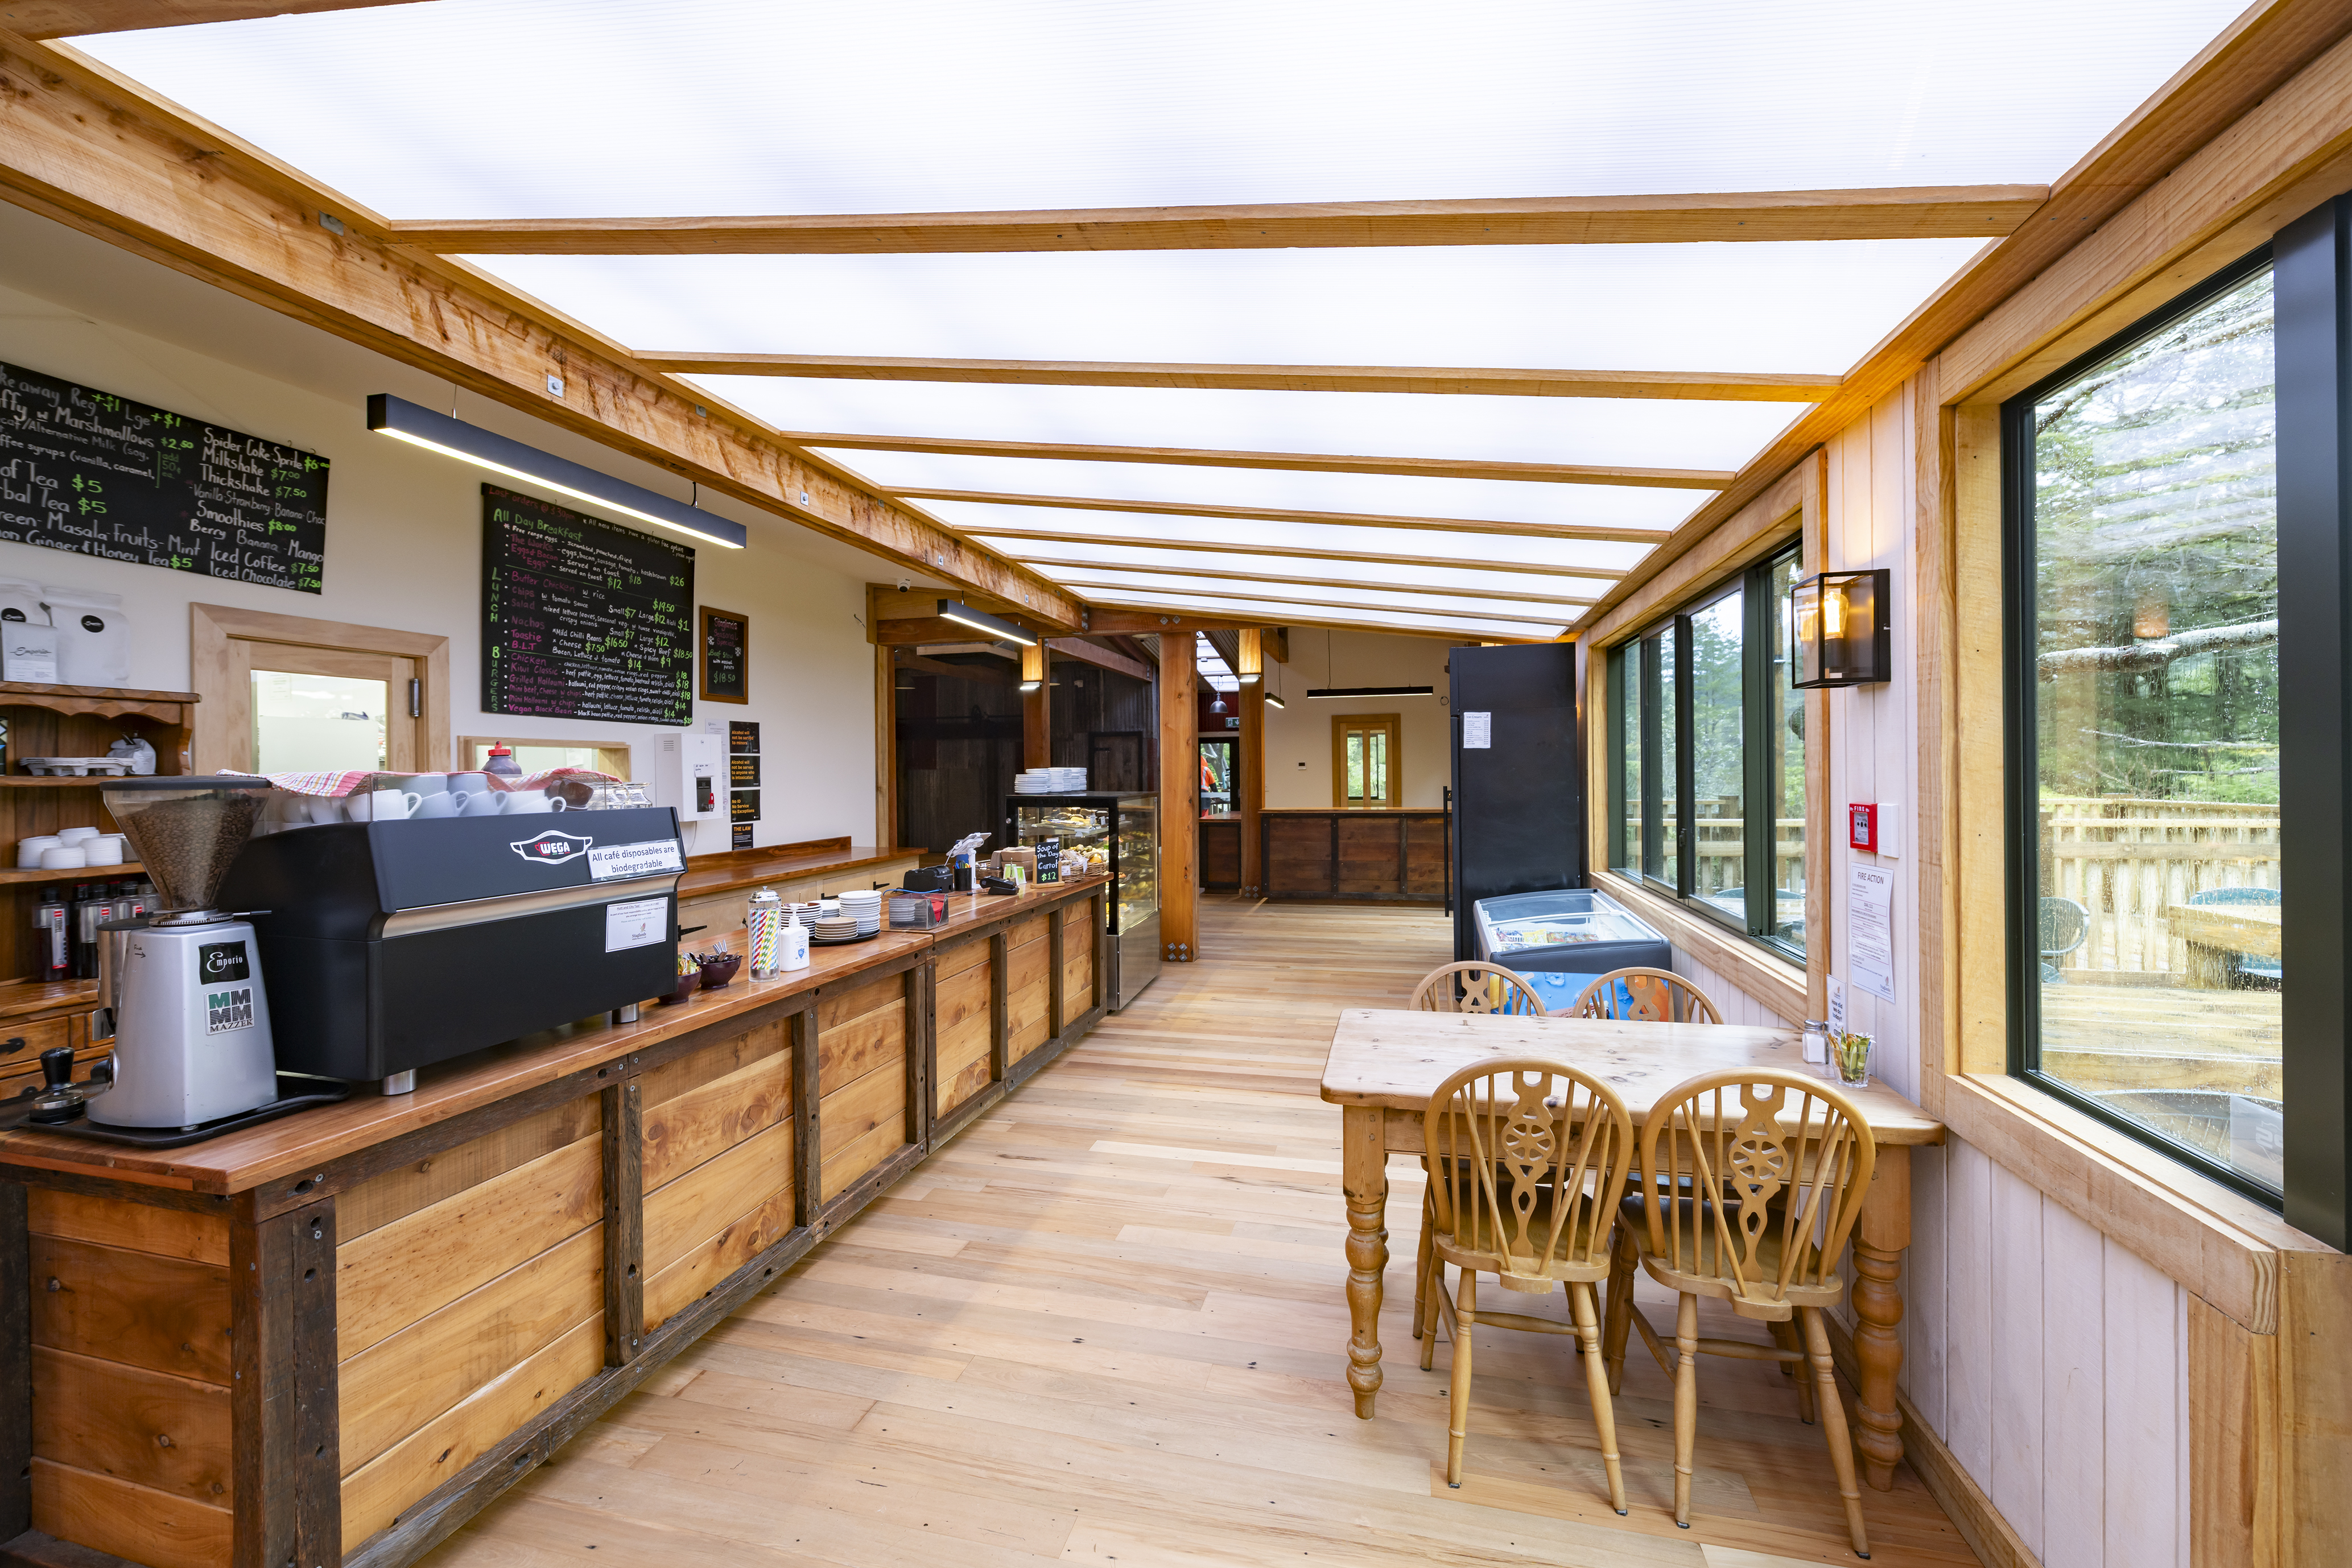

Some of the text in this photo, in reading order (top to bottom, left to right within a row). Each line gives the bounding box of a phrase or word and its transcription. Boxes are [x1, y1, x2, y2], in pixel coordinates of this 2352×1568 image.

[71, 387, 97, 416] Reg
[125, 404, 151, 430] Lge
[55, 406, 155, 448] Marshmallows
[27, 444, 66, 460] syrups
[92, 436, 116, 451] Milk
[202, 447, 264, 476] Milkshake
[0, 458, 103, 493] of Tea $5
[199, 463, 307, 499] Thickshake $7.50
[39, 486, 108, 515] Tea $5
[196, 500, 265, 532] Smoothies
[493, 508, 583, 542] All Day Breakfast
[512, 525, 525, 534] Free
[168, 534, 201, 555] Mint
[189, 519, 279, 552] Berry Banana
[93, 541, 139, 563] Honey
[146, 549, 170, 567] Tea
[170, 554, 193, 569] $5
[211, 542, 320, 574] Iced Coffee $7.50
[510, 534, 525, 544] The
[527, 538, 554, 551] Works
[669, 575, 684, 587] $26
[537, 550, 642, 584] Bacon toast $18
[210, 560, 321, 589] Iced Chocolate $7.50
[511, 571, 539, 585] Butter
[543, 579, 575, 593] Chicken
[593, 590, 605, 599] rice
[588, 572, 622, 590] toast $12
[511, 599, 670, 647] Salad Small $7 Large $12
[552, 593, 571, 604] tomato
[608, 605, 625, 615] Small
[625, 606, 636, 619] $7
[638, 610, 654, 623] Large
[654, 612, 666, 624] $12
[678, 617, 690, 632] $1
[511, 615, 545, 630] Nachos
[570, 631, 585, 639] Chilli
[586, 633, 603, 643] Beans
[639, 643, 657, 656] Spicy
[658, 647, 672, 657] Beef
[511, 629, 542, 642] Toastie
[559, 639, 582, 650] Cheese
[660, 655, 671, 668] $9
[714, 629, 738, 641] Seasonal
[717, 637, 736, 647] Special
[511, 653, 687, 680] Chicken $18
[601, 655, 621, 664] tomato
[628, 657, 642, 671] $14
[708, 649, 721, 658] Beef
[509, 674, 691, 702] Grilled Halloumi $18
[510, 662, 690, 691] Kiwi Classic $18
[713, 670, 736, 684] $18.50
[508, 694, 523, 704] Mini
[523, 696, 548, 704] Halloumi
[663, 707, 676, 720] $14
[509, 684, 687, 712] Mini $14
[508, 703, 533, 715] Vegan
[554, 707, 573, 715] Bean
[683, 715, 693, 727] $20
[540, 841, 571, 855] WEGA
[592, 852, 602, 861] All
[605, 850, 620, 860] café
[622, 846, 663, 859] disposables
[1037, 844, 1051, 853] Soup
[612, 859, 663, 873] biodegradable
[1038, 859, 1058, 869] Carrot
[1041, 871, 1056, 881] $12
[1858, 872, 1884, 884] FIRE ACTION
[207, 952, 243, 973] Emporio
[210, 1018, 253, 1033] MAZZER
